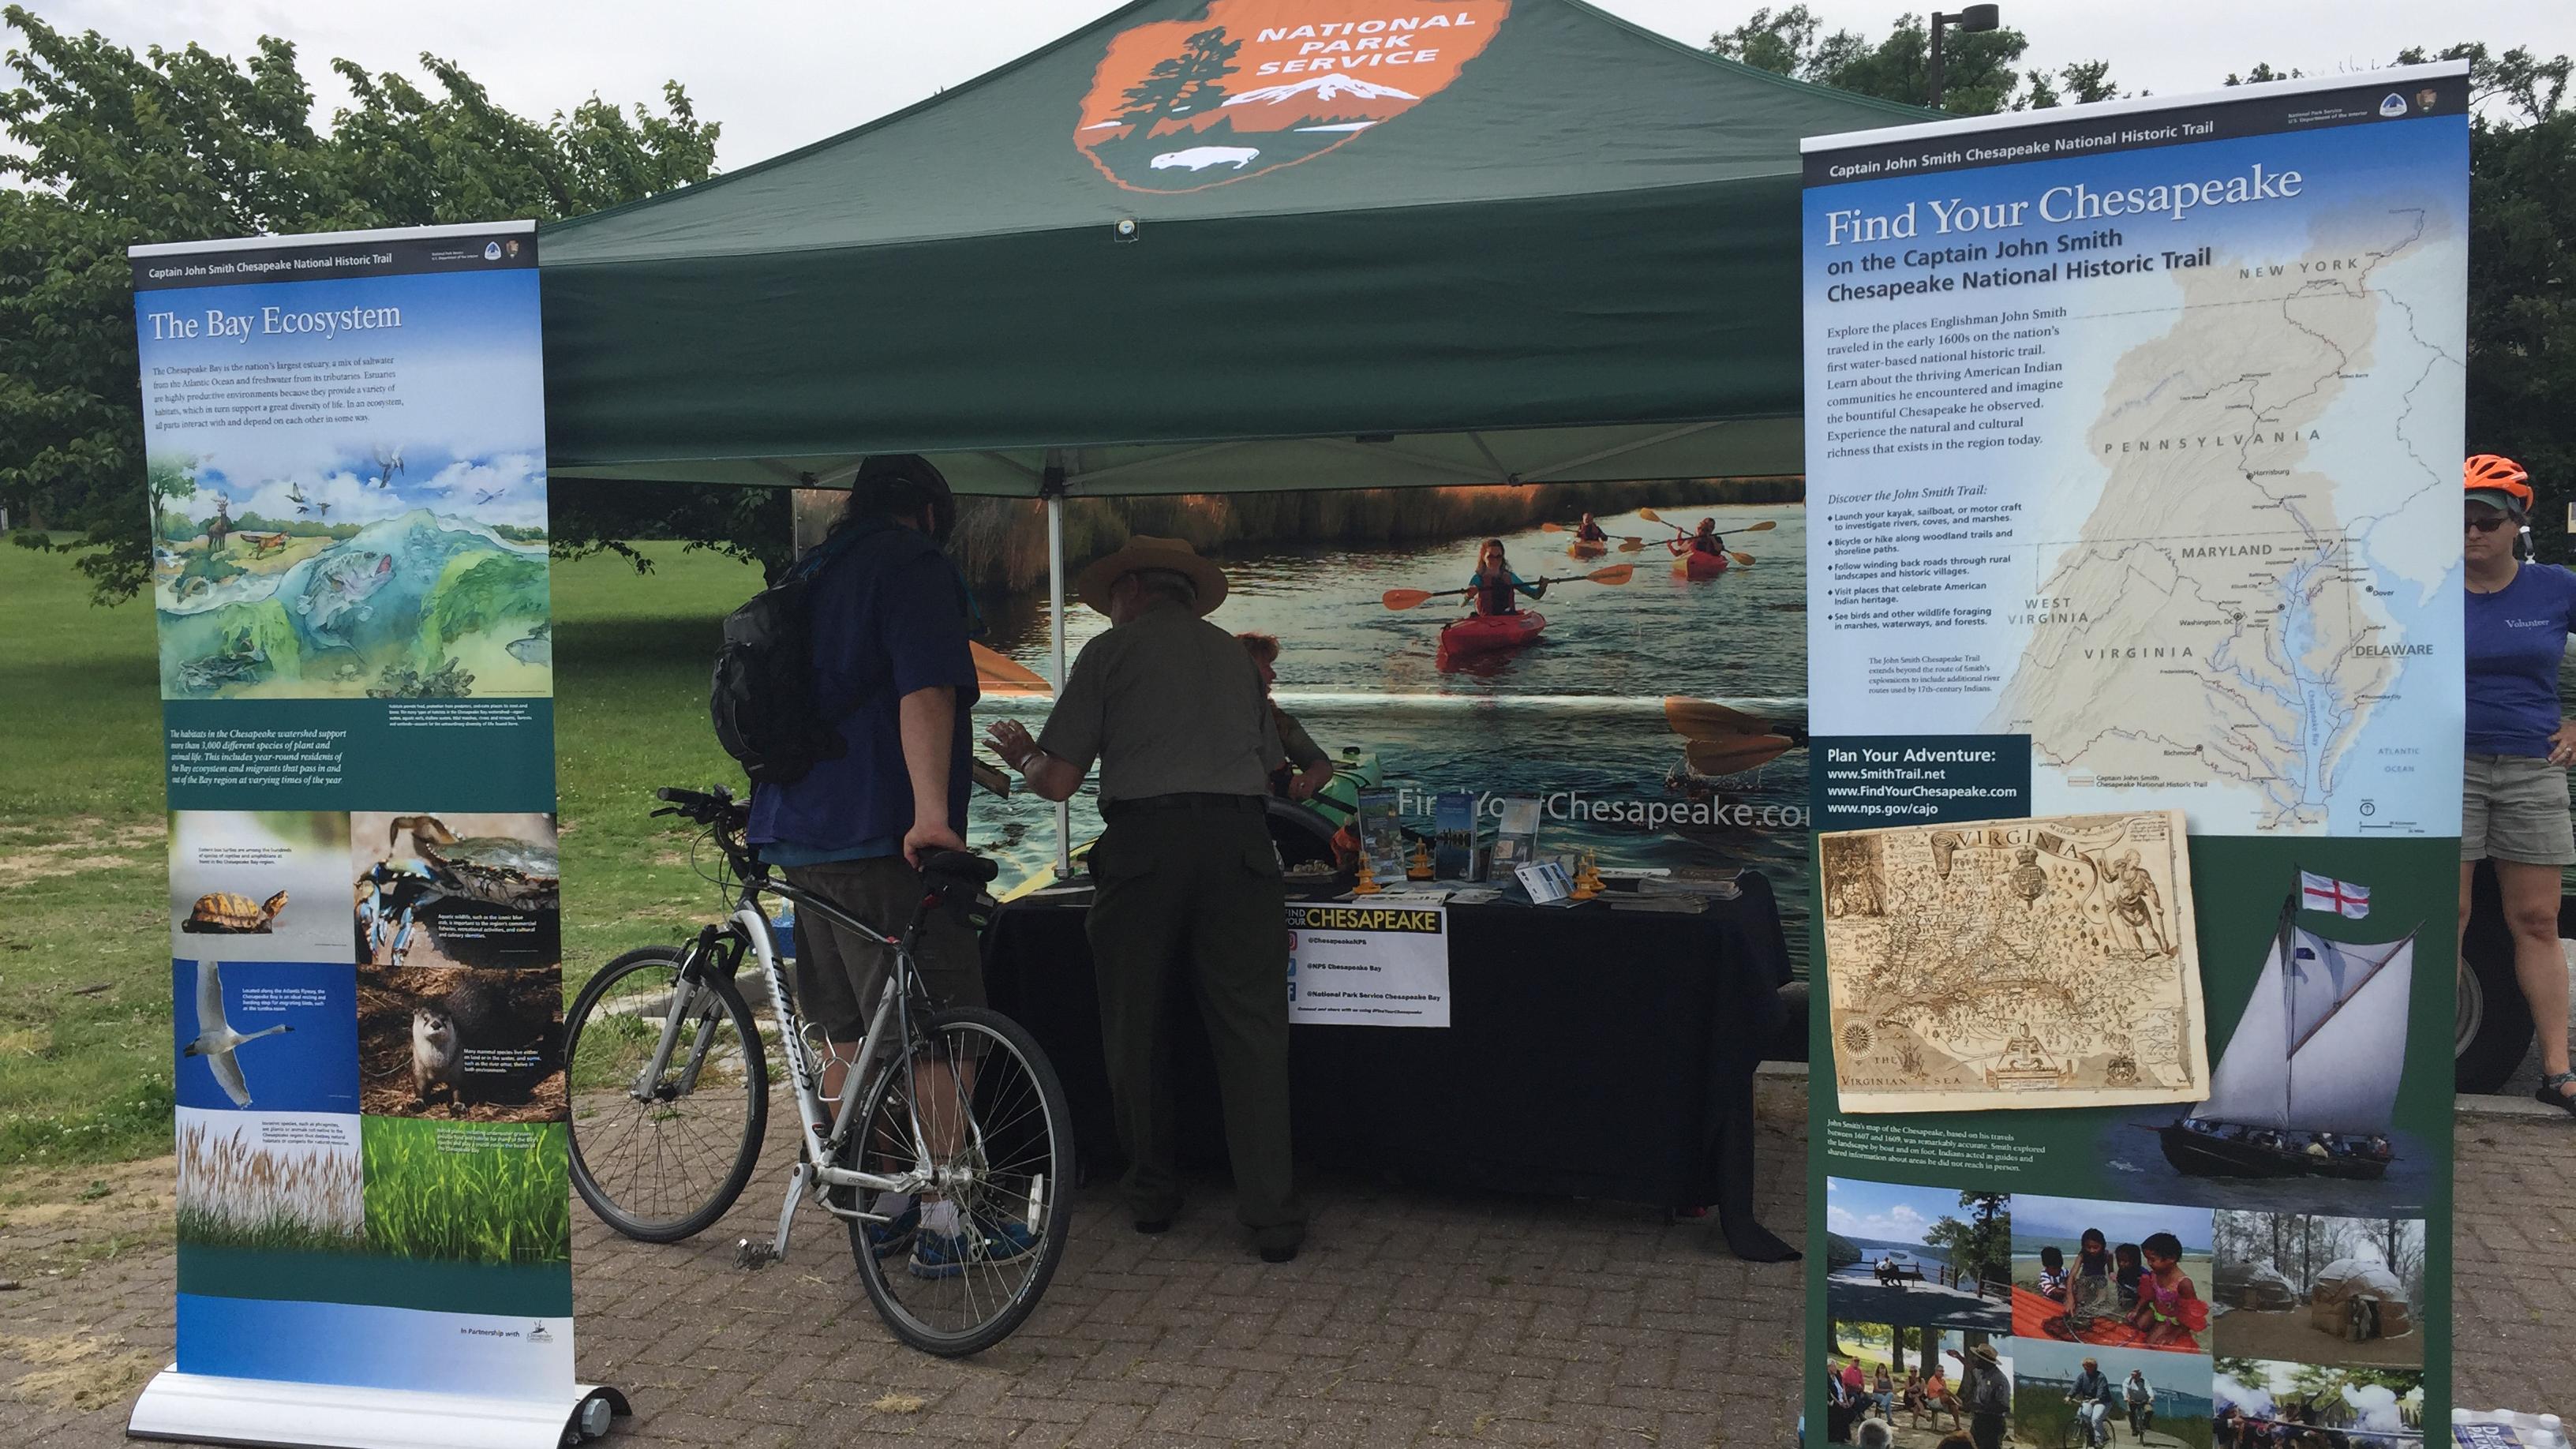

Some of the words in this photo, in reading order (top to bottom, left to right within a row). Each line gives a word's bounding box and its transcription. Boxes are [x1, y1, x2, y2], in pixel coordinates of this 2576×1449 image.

[1256, 13, 1474, 42] NATIONAL
[1298, 34, 1413, 54] PARK
[1256, 49, 1439, 75] SERVICE
[1829, 161, 1879, 178] Captain
[1885, 157, 1916, 170] John
[1922, 151, 1960, 166] Smith
[1966, 141, 2050, 160] Chesapeake
[2055, 132, 2115, 150] National
[2121, 125, 2177, 142] Historic
[2182, 122, 2212, 135] Trail
[1825, 201, 1917, 246] Find
[1927, 198, 2028, 234] Your
[2039, 163, 2301, 223] Chesapeake
[1827, 260, 1852, 275] on
[1860, 253, 1895, 271] the
[1904, 243, 1986, 268] Captain
[1995, 238, 2047, 258] John
[2057, 228, 2121, 252] Smith
[149, 267, 182, 279] Captain
[185, 265, 205, 275] John
[208, 264, 234, 274] Smith
[237, 260, 290, 272] Chesapeake
[294, 256, 331, 268] National
[335, 255, 370, 265] Historic
[373, 253, 391, 263] Trail
[1828, 274, 1953, 301] Chesapeake
[1963, 263, 2056, 288] National
[2067, 253, 2153, 279] Historic
[2161, 246, 2210, 268] Trail
[2240, 265, 2284, 279] NEW
[2300, 259, 2358, 274] YORK
[148, 312, 198, 339] The
[206, 309, 254, 344] Bay
[261, 306, 401, 340] Ecosystem
[1828, 325, 1868, 339] Explore
[1872, 323, 1889, 332] the
[1893, 320, 1926, 334] places
[1931, 315, 1998, 328] Englishman
[2002, 311, 2028, 324] John
[2032, 306, 2065, 319] Smith
[1827, 341, 1868, 354] traveled
[1873, 341, 1882, 350] in
[1887, 339, 1904, 348] the
[1907, 335, 1934, 348] early
[1939, 333, 1969, 344] 1600s
[1992, 330, 2009, 339] the
[2013, 325, 2059, 338] nation's
[1827, 362, 1846, 372] first
[1850, 354, 1916, 369] water-based
[1920, 350, 1966, 363] national
[1971, 347, 2014, 359] historic
[2018, 344, 2044, 355] trail.
[1828, 380, 1857, 388] Learn
[1860, 376, 1891, 385] about
[1895, 373, 1911, 382] the
[1916, 369, 1960, 380] thriving
[1964, 366, 2020, 377] American
[2024, 361, 2061, 373] Indian
[1827, 391, 1895, 406] communities
[1900, 390, 1911, 399] he
[1915, 384, 1986, 398] encountered
[1991, 382, 2012, 393] and
[2016, 380, 2062, 392] imagine
[2105, 429, 2320, 453] PENNSYLVANIA
[1828, 494, 1872, 504] Discover
[1874, 490, 1890, 500] the
[1892, 489, 1918, 501] John
[1922, 486, 1953, 497] Smith
[1957, 485, 1986, 495] Trail:
[1835, 511, 1862, 522] Launch
[1865, 512, 1884, 522] your
[1887, 508, 1914, 521] kayak,
[1918, 507, 1954, 519] sailboat,
[1835, 521, 1842, 530] to
[1845, 519, 1890, 530] investigate
[1893, 517, 1919, 526] rivers,
[2182, 545, 2272, 558] MARYLAND
[2025, 598, 2071, 609] WEST
[2009, 612, 2088, 624] VIRGINIA
[2505, 619, 2549, 628] Volunteer
[2085, 647, 2192, 659] VIRGINIA
[2355, 644, 2433, 656] DELAWARE
[208, 730, 215, 739] in
[216, 729, 227, 739] the
[230, 729, 275, 740] Chesapeake
[277, 729, 317, 738] watershed
[318, 731, 346, 740] support
[1828, 748, 1856, 761] Plan
[1862, 749, 1898, 761] Your
[1904, 747, 1994, 761] Adventure:
[1827, 768, 1945, 778] www.SmithTrail.net
[1827, 785, 2016, 799] www.FindYourChesapeake.com
[1828, 803, 1938, 816] www.nps.gov/cajo
[1956, 829, 2079, 858] VIRGINIA
[1307, 909, 1436, 931] CHESAPEAKE
[468, 1328, 504, 1337] Partnership
